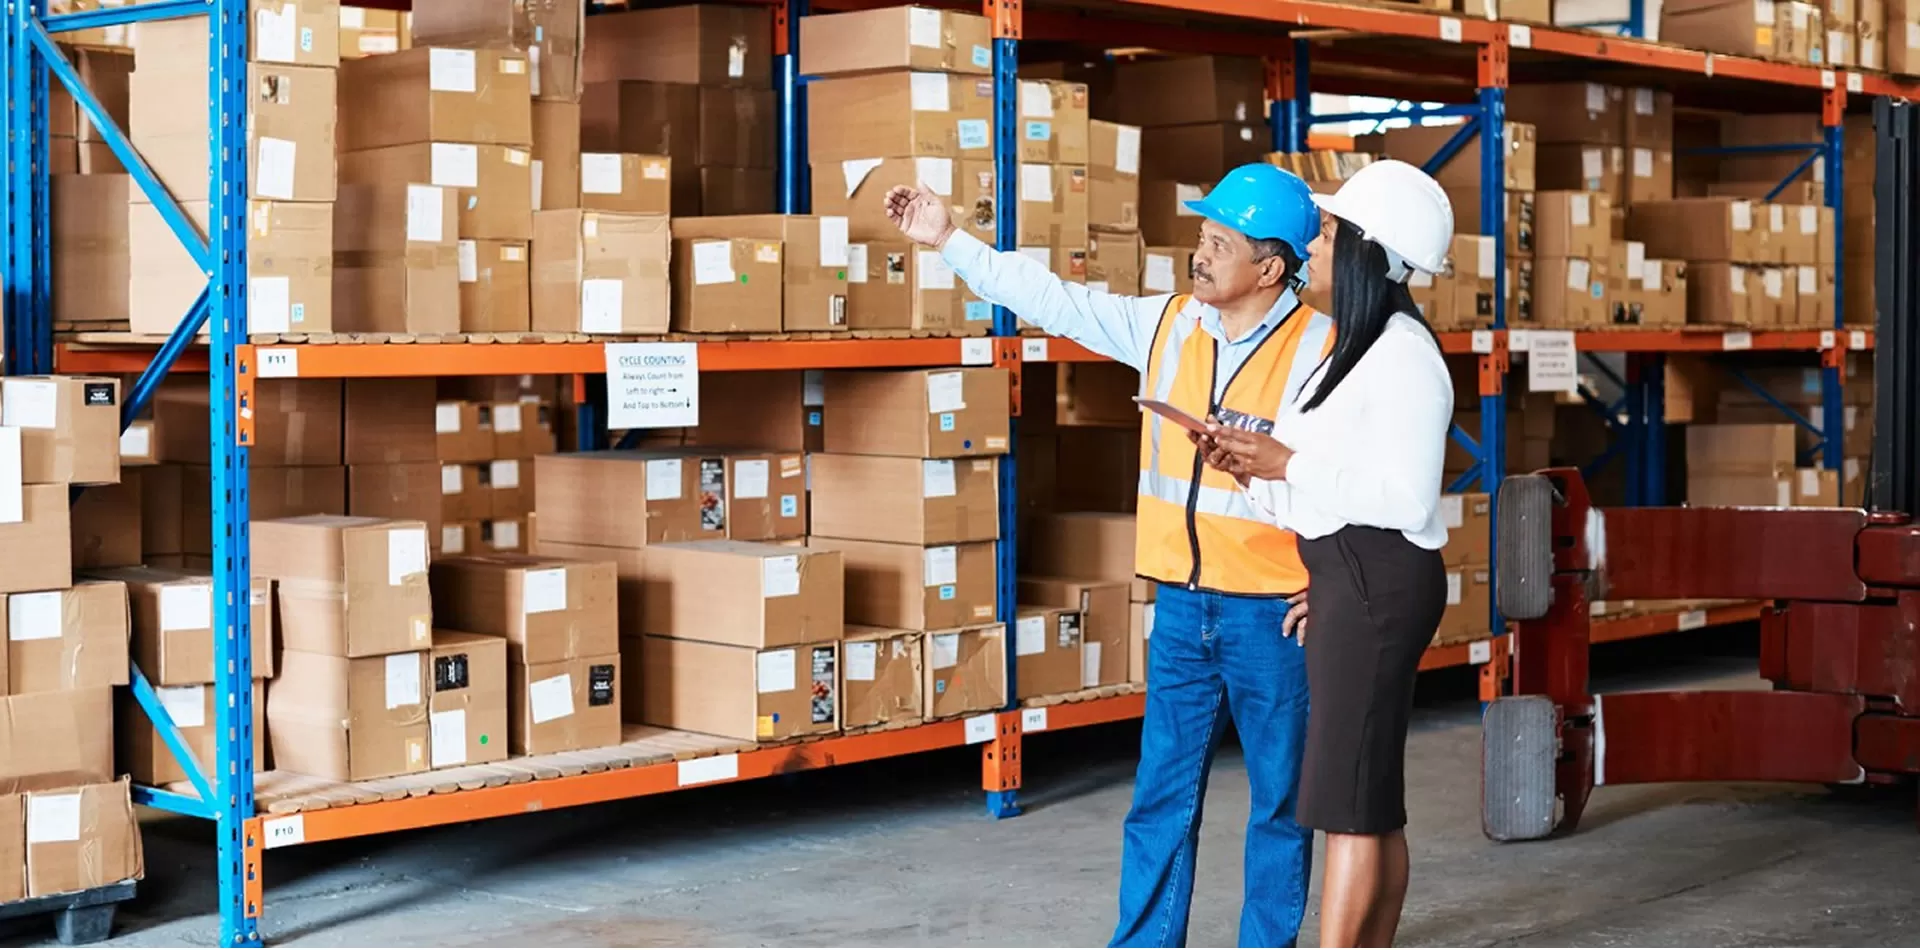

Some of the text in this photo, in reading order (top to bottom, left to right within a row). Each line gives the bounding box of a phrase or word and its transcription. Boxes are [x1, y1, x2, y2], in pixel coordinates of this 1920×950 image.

[268, 355, 286, 364] F11
[619, 355, 686, 366] CYCLE COUNTING
[623, 371, 684, 381] Always Count from
[626, 386, 665, 396] Left to right
[623, 401, 684, 410] And Top to Bottom
[275, 826, 293, 837] F10
